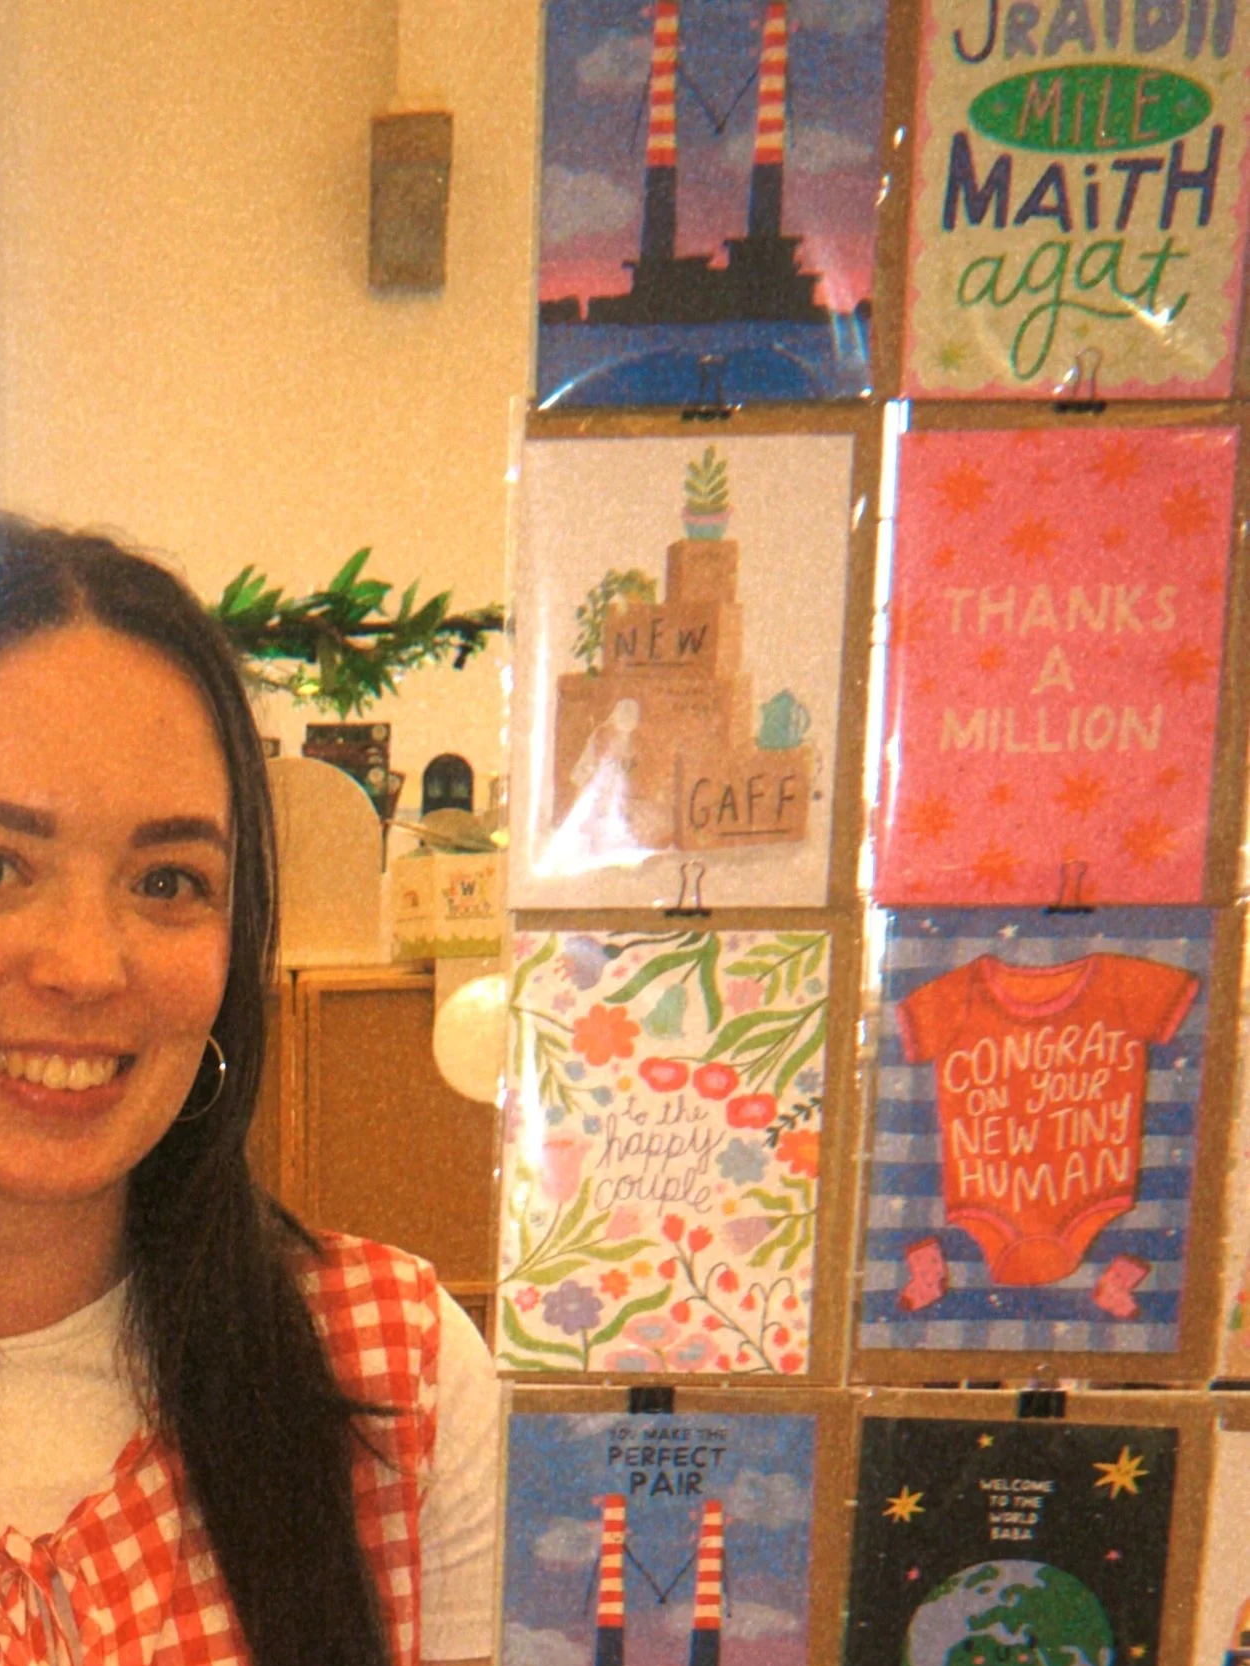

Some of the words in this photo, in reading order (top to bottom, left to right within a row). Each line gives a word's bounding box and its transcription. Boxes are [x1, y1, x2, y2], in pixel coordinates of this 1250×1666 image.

[956, 236, 1190, 381] agat
[942, 584, 1178, 636] THANKS
[614, 617, 707, 660] NEW
[1031, 644, 1075, 695] A
[939, 703, 1164, 753] MILLION
[689, 775, 797, 829] GAFF
[943, 1021, 1140, 1093] CONGRATS
[622, 1093, 648, 1125] to
[656, 1094, 709, 1125] the
[966, 1085, 1009, 1116] ON
[1026, 1067, 1110, 1114] YOUR
[595, 1112, 726, 1174] happy
[952, 1116, 1040, 1158] NEW
[1048, 1093, 1132, 1151] TINY
[594, 1167, 712, 1217] couple
[957, 1147, 1129, 1213] HUMAN
[608, 1446, 726, 1467] PERFECT
[630, 1471, 703, 1497] PAIR
[979, 1478, 1055, 1493] WELCOME
[989, 1495, 1009, 1507] TO
[1012, 1495, 1044, 1508] THE
[989, 1511, 1039, 1525] WORLD
